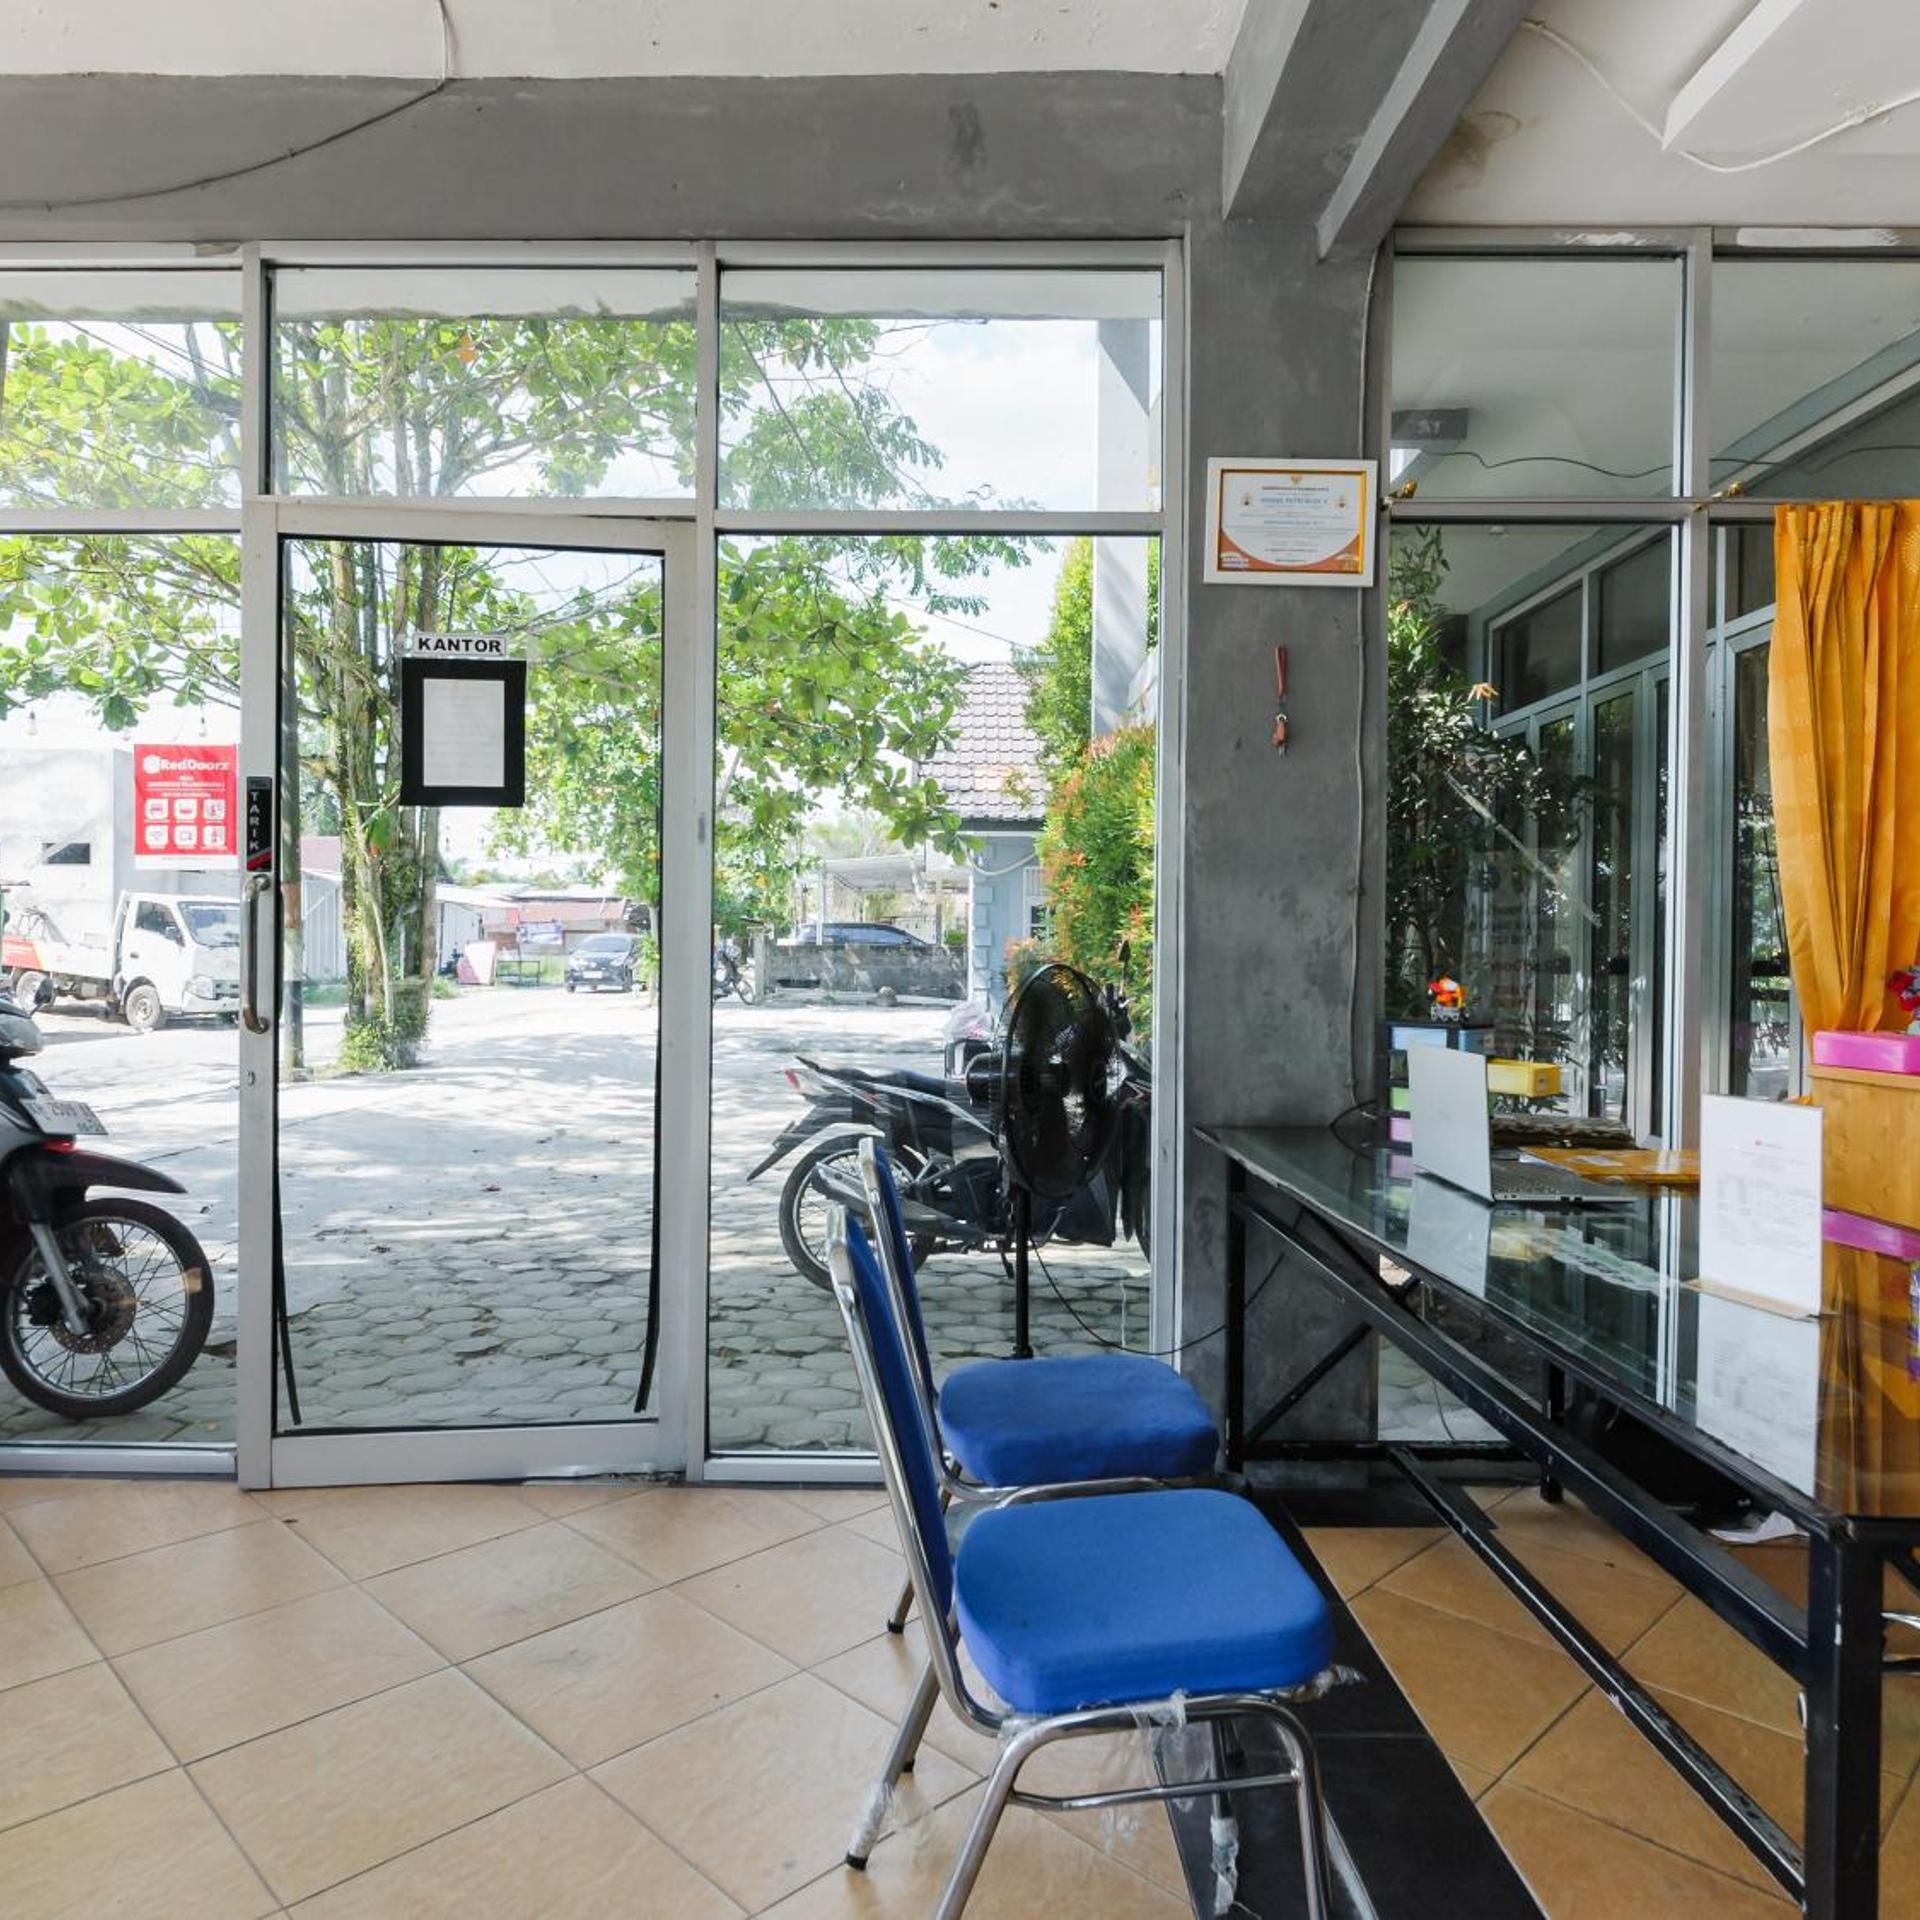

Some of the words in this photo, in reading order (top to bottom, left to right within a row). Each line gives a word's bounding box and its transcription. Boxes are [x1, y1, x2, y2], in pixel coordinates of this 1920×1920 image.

[418, 637, 502, 653] KANTOR
[160, 758, 230, 771] RedDoorz
[250, 791, 260, 851] TARIK
